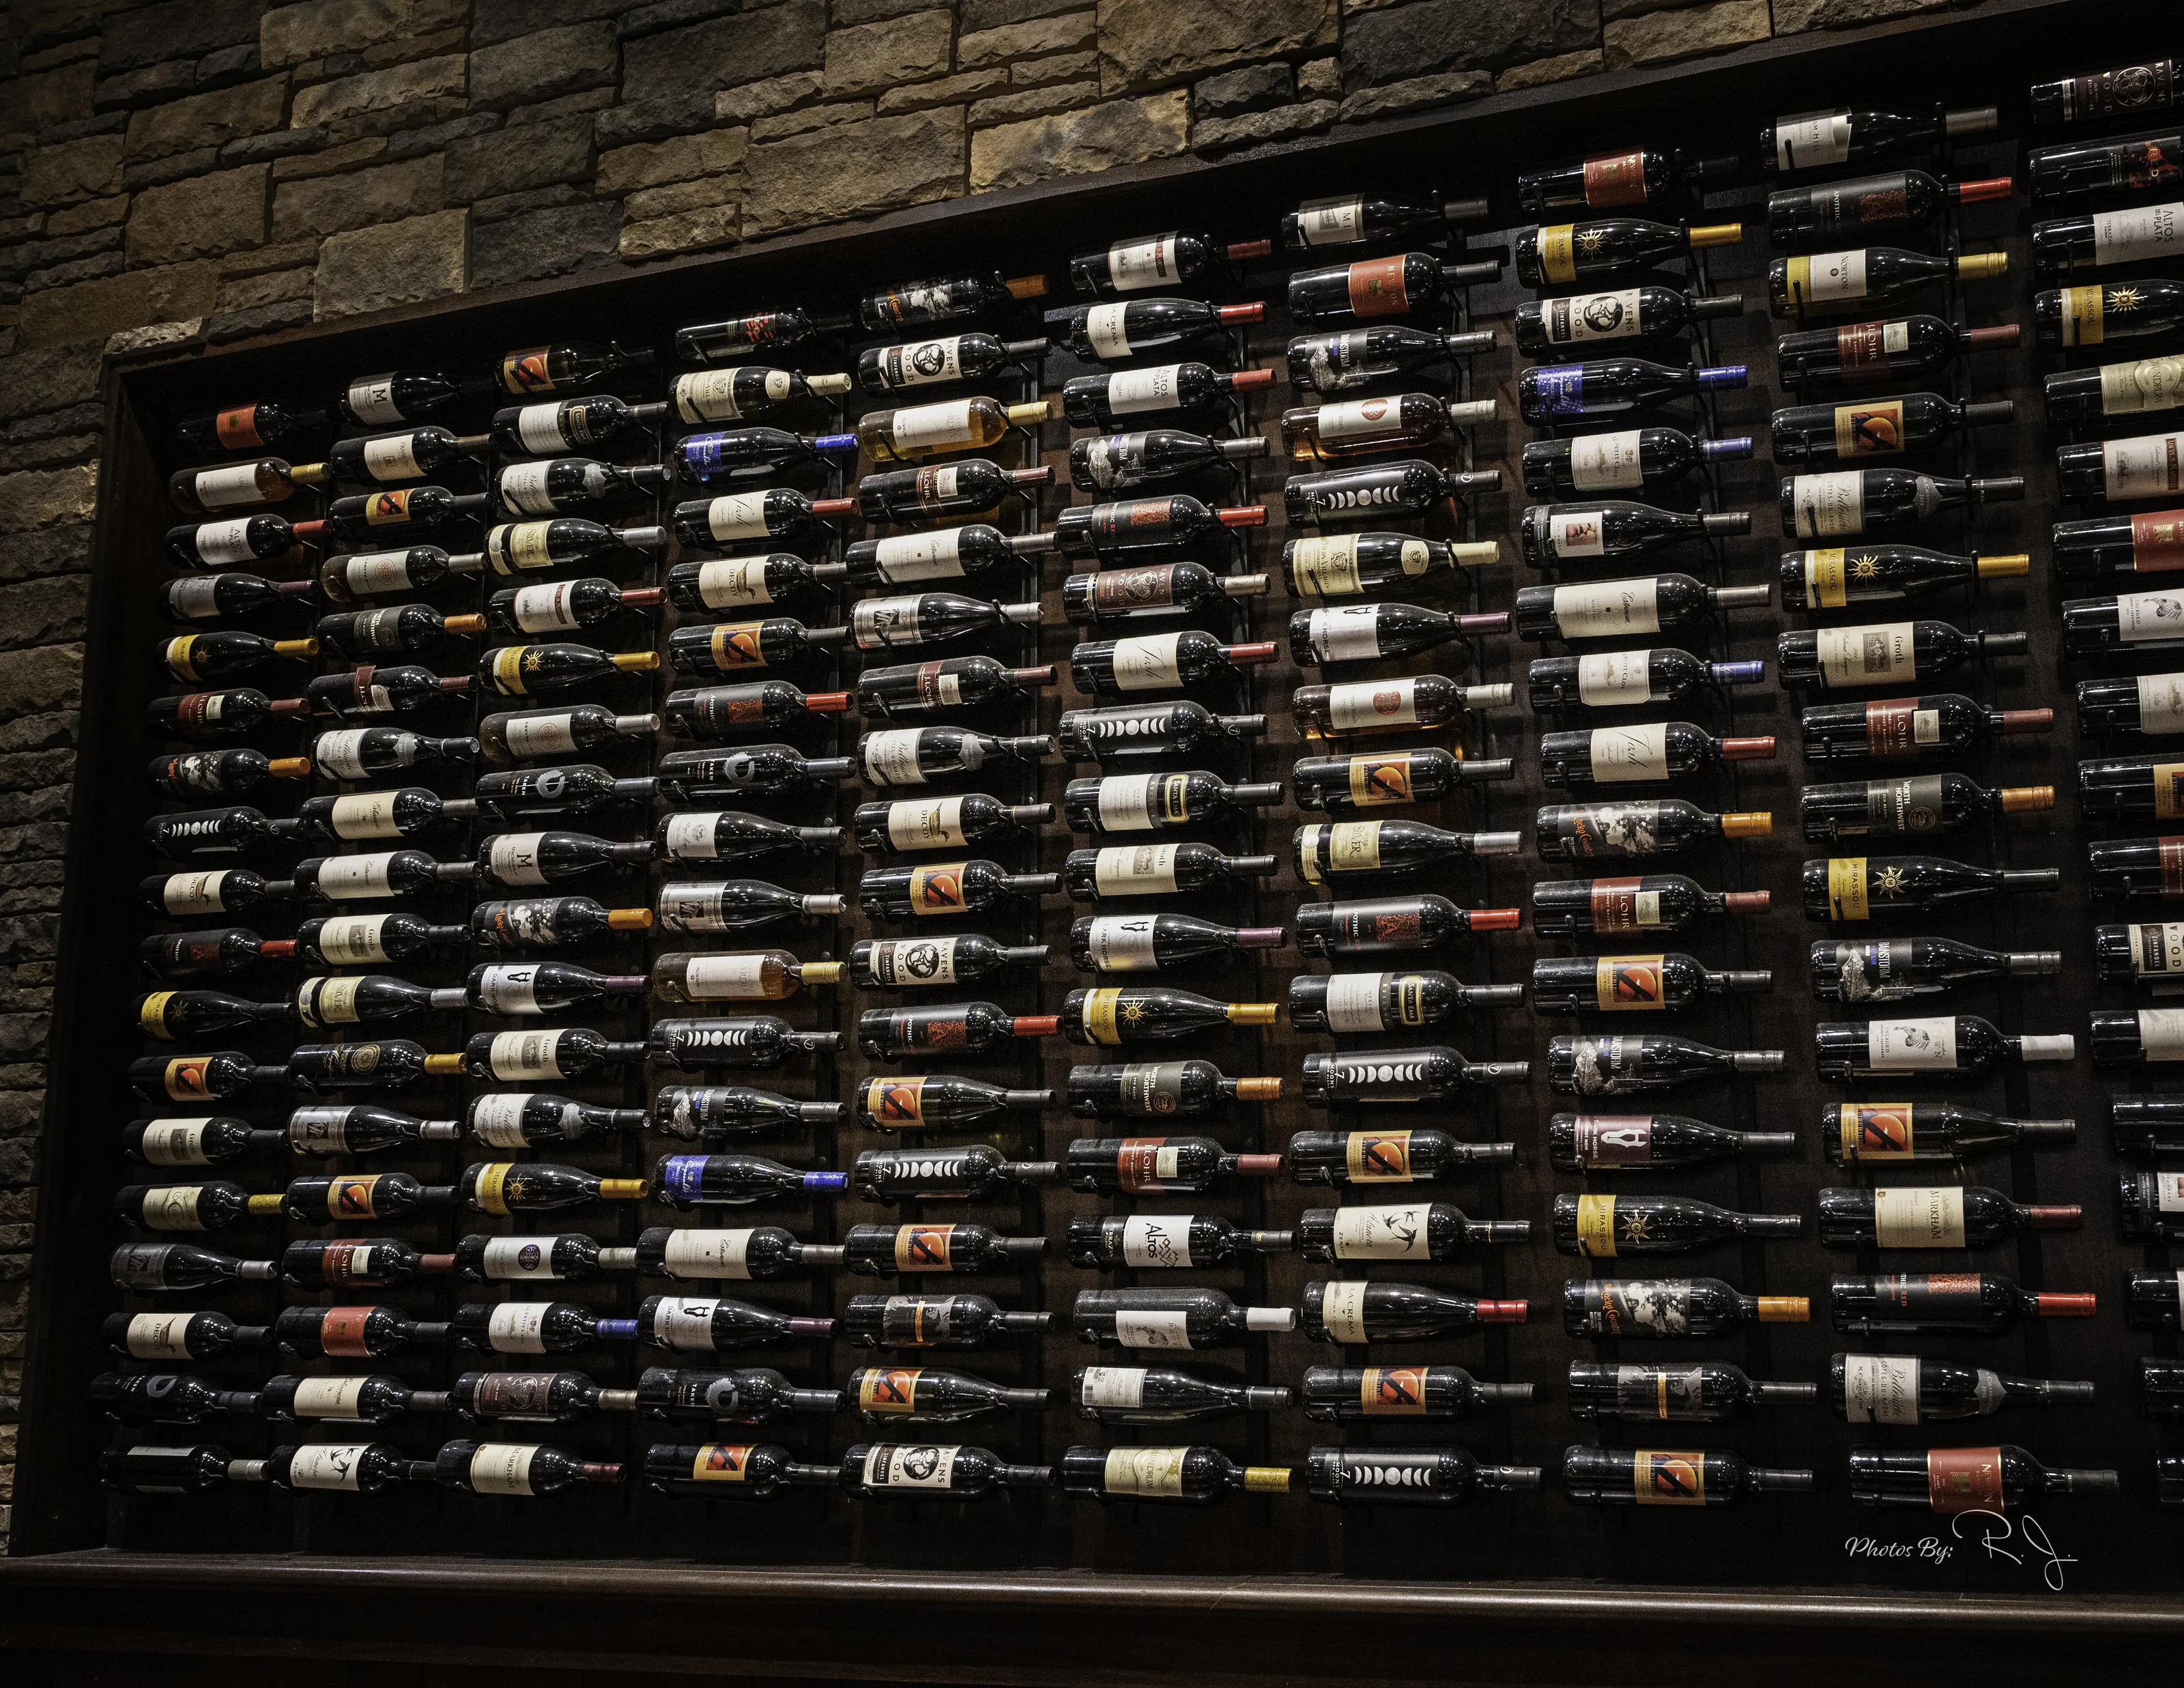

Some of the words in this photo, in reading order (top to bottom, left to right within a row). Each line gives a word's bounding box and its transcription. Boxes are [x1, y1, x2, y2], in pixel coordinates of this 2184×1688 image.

[2155, 61, 2166, 103] RAVENS
[2150, 147, 2159, 177] RED
[2154, 216, 2162, 243] PLATA
[2163, 210, 2174, 243] ALTOS
[1841, 256, 1849, 290] NORTON
[1625, 292, 1634, 332] RAVENS
[2086, 288, 2095, 328] MIRASSOU
[1110, 316, 1119, 346] CREMA
[893, 356, 901, 383] ZINFANDEL
[947, 339, 956, 375] RAVENS
[373, 388, 388, 403] M
[1160, 369, 1170, 397] ALTOS
[731, 496, 755, 528] Josh
[929, 539, 941, 567] Estancia
[728, 568, 739, 598] DECOY
[1829, 553, 1837, 592] MIRASSOU
[1620, 592, 1635, 625] Estancia
[1322, 628, 1330, 655] HORSE
[1894, 635, 1904, 663] Groth
[1136, 639, 1166, 681] Josh
[1611, 728, 1653, 769] Josh
[1173, 780, 1181, 800] SANTA
[1903, 780, 1912, 805] NORTH
[921, 809, 931, 840] DECOY
[1895, 787, 1905, 831] NORTHWEST
[1158, 846, 1170, 867] Groth
[1349, 827, 1361, 857] SILVER
[517, 853, 533, 869] M
[1852, 863, 1860, 910] MIRASSOU
[897, 943, 906, 982] WOOD
[1101, 943, 1112, 968] HORSE
[1878, 941, 1891, 979] RAINSTORM
[2152, 936, 2161, 967] ZINFANDEL
[1102, 995, 1110, 1035] MIRASSOU
[1151, 1064, 1160, 1088] NORTH
[1334, 1071, 1345, 1080] 7
[1143, 1070, 1153, 1113] NORTHWEST
[1930, 1190, 1942, 1240] MARKHAM
[1145, 1222, 1167, 1259] ALTOS
[1348, 1288, 1355, 1300] LA
[1347, 1301, 1356, 1335] CREMA
[1605, 1308, 1622, 1336] Country
[505, 1446, 523, 1489] MARKHAM
[1340, 1470, 1351, 1480] 7
